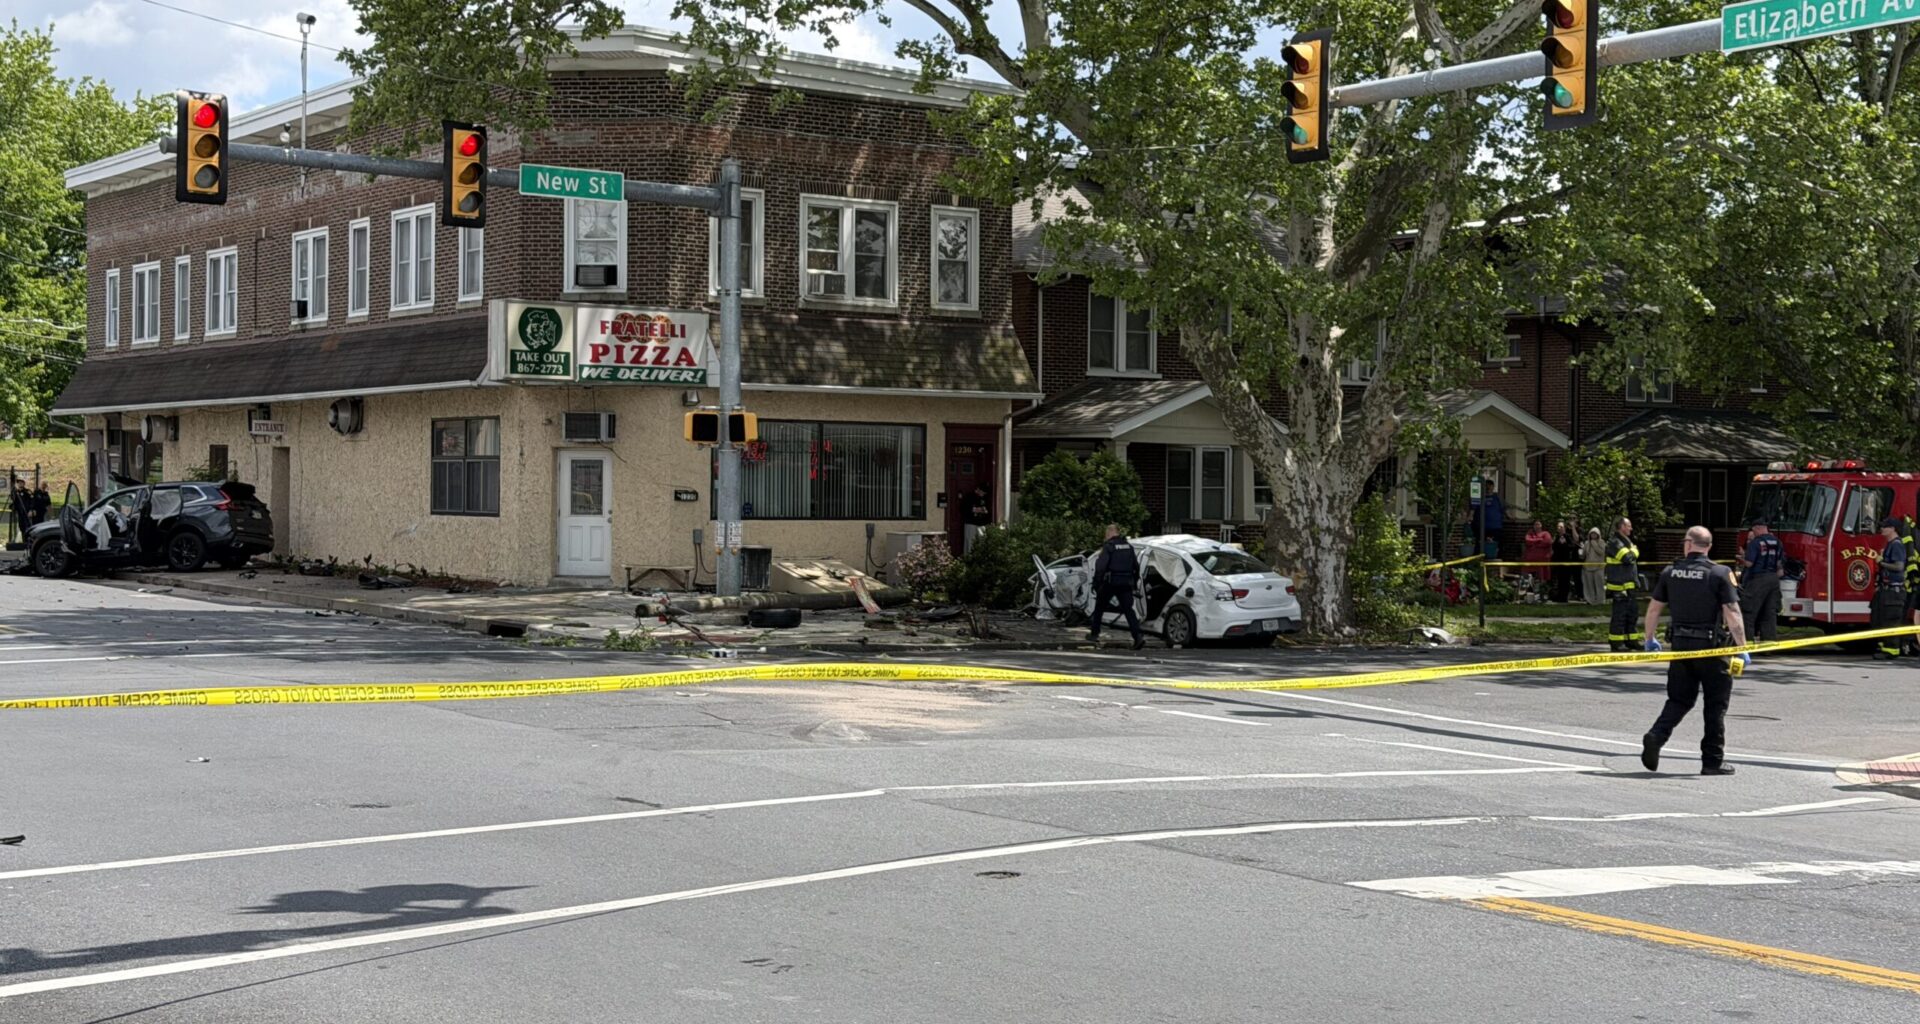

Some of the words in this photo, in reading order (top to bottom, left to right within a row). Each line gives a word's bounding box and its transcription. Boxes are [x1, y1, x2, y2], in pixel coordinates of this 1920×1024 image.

[1735, 0, 1866, 40] Elizabeth
[537, 172, 580, 192] New
[589, 176, 607, 195] St
[600, 320, 687, 338] FRATELLI
[514, 351, 540, 362] TAKE
[543, 352, 566, 364] OUT
[589, 343, 698, 367] PIZZA
[517, 363, 563, 375] 867-2773
[581, 366, 614, 379] WE
[616, 368, 704, 383] DELIVER!
[254, 422, 286, 433] ENTRANCE
[1671, 569, 1704, 579] POLICE
